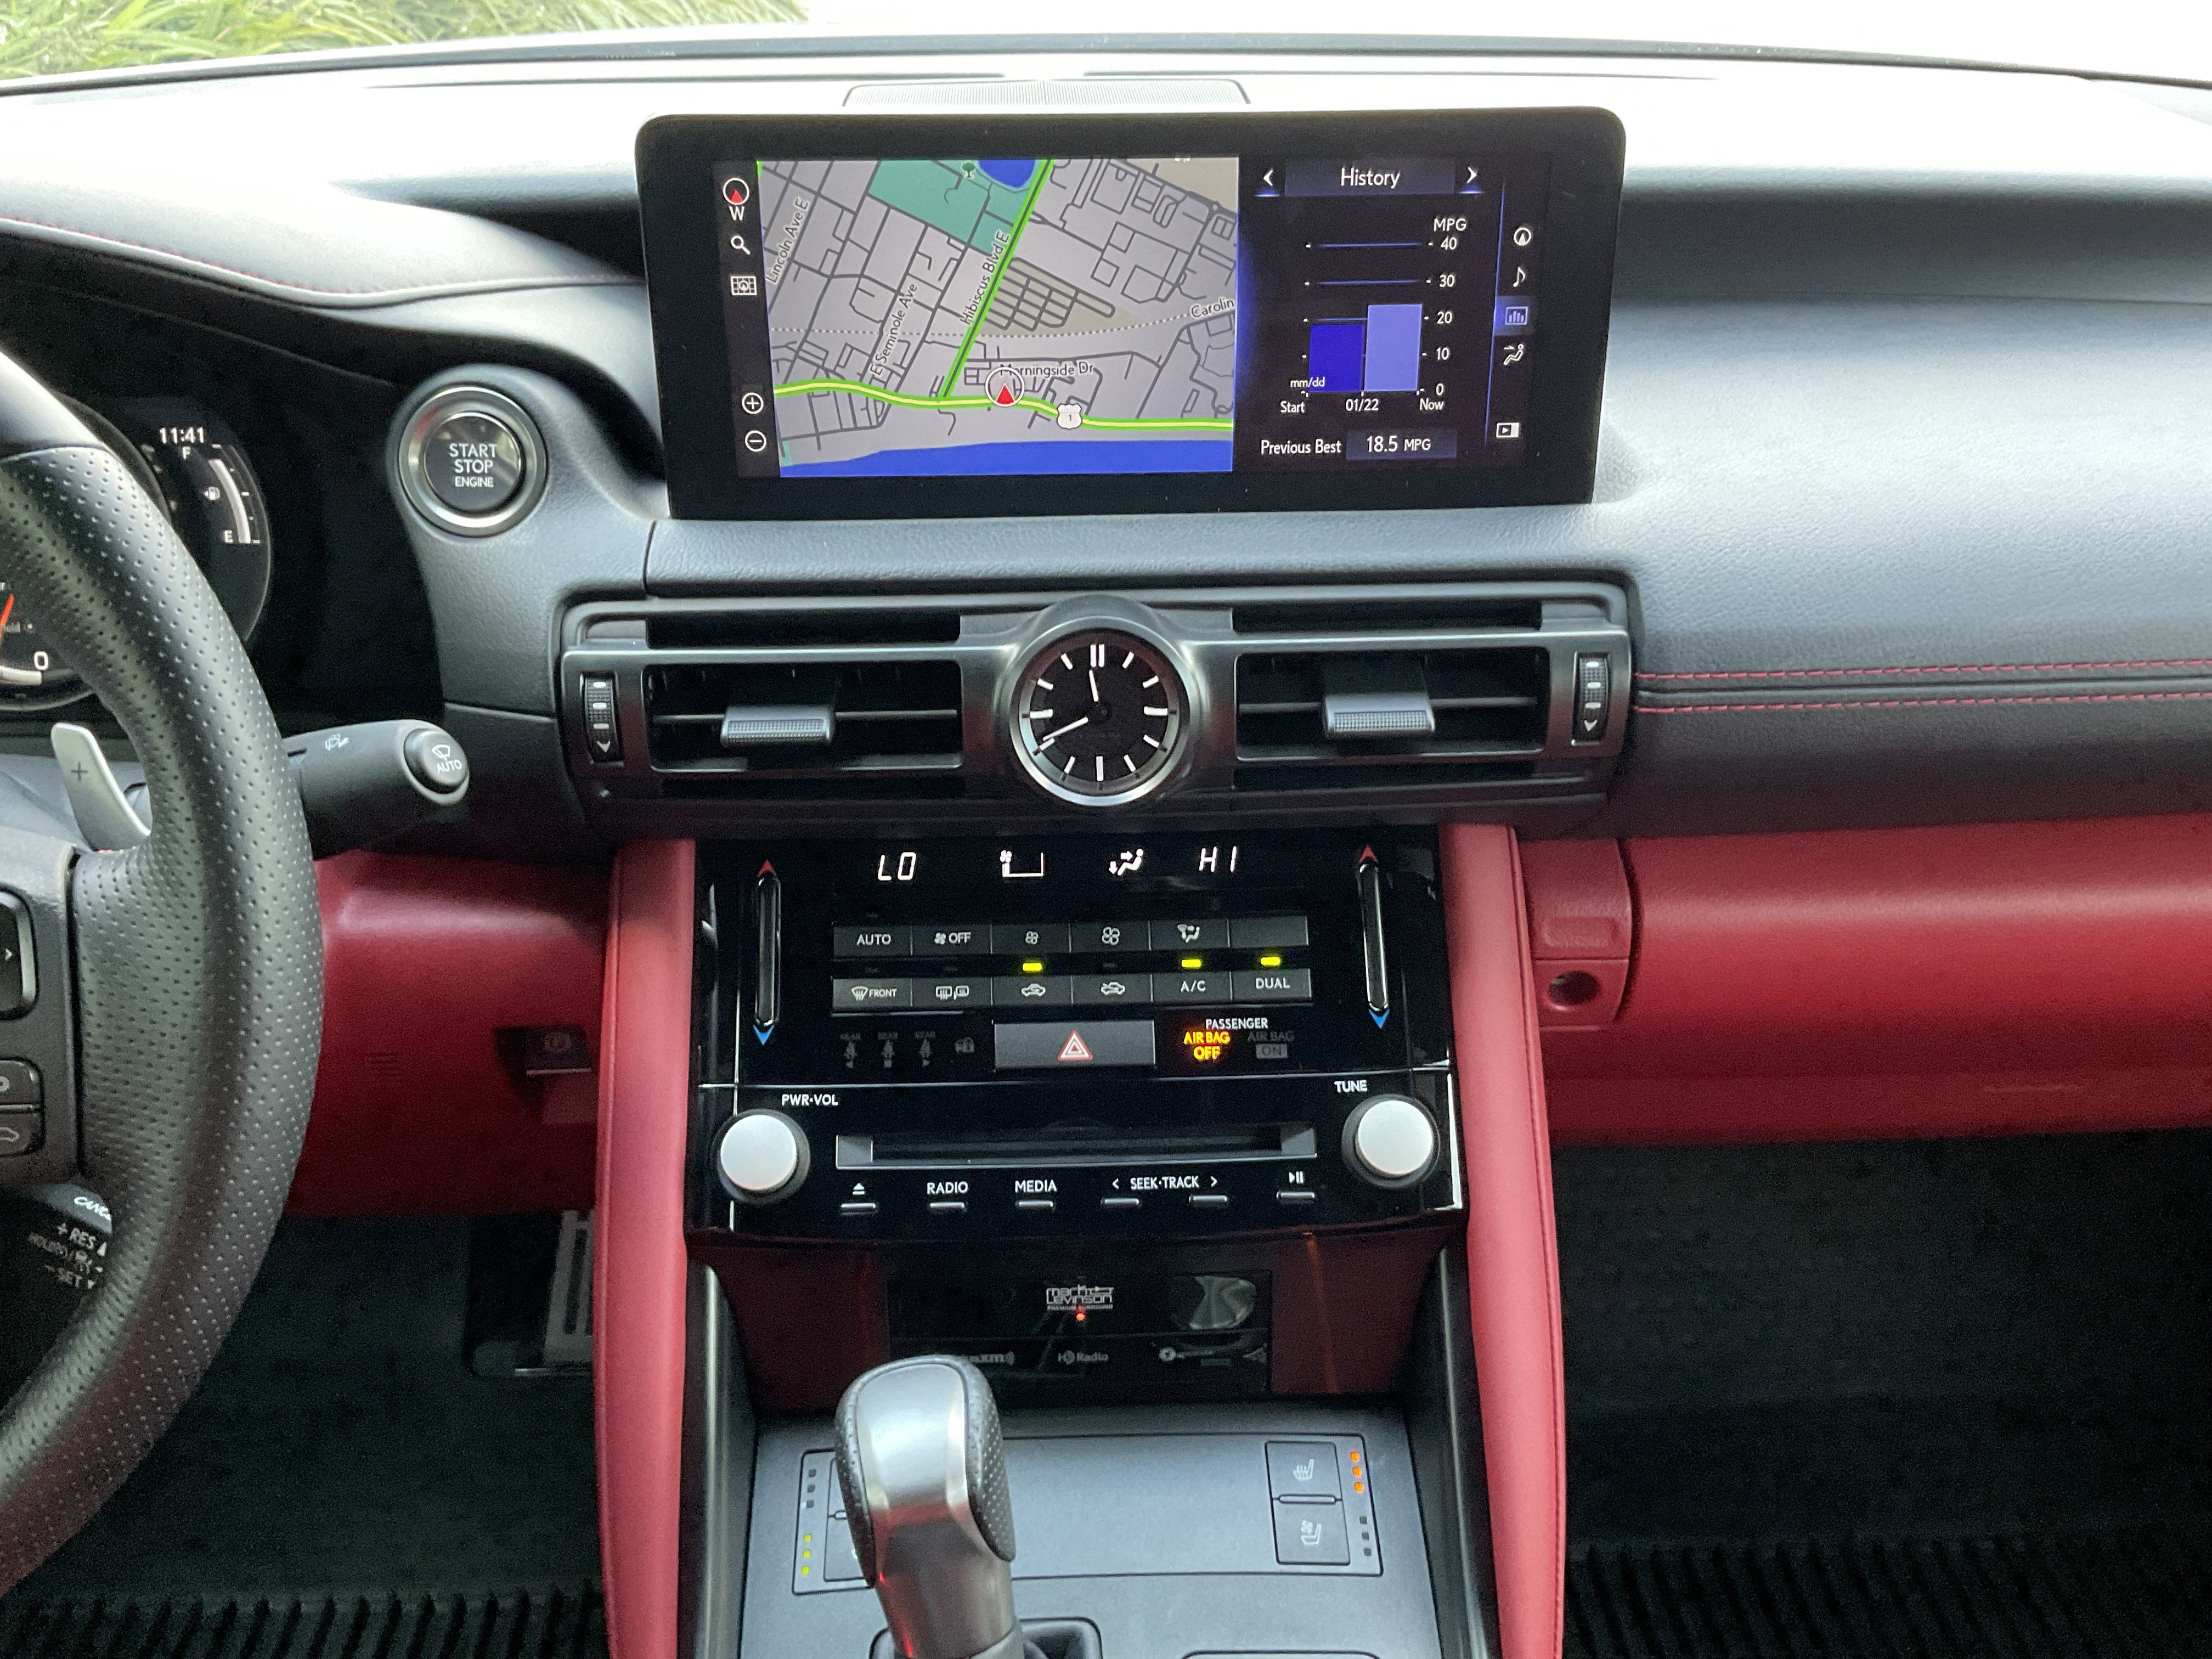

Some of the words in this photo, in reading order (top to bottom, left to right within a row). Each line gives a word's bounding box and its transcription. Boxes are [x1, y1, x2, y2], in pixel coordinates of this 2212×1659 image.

[1341, 168, 1400, 189] History
[729, 206, 745, 221] W
[1433, 218, 1467, 232] MPG
[766, 239, 792, 284] Lincoln
[785, 211, 803, 238] Ave
[795, 198, 809, 210] E
[1441, 237, 1458, 250] 40
[960, 276, 990, 325] Hibiscus
[982, 242, 1003, 273] Blvd
[996, 230, 1009, 243] E
[1439, 274, 1455, 287] 30
[899, 284, 917, 309] Ave
[1191, 298, 1234, 318] Carolin
[1437, 311, 1453, 325] 20
[876, 308, 905, 364] Seminole
[1436, 347, 1450, 360] 10
[870, 363, 883, 376] E
[1079, 362, 1093, 374] Dr
[1290, 376, 1325, 388] mm/dd
[1436, 383, 1444, 396] 0
[1280, 400, 1305, 413] Start
[1345, 398, 1379, 412] 01/22
[1419, 398, 1444, 410] Now
[159, 427, 205, 444] 11:41
[449, 442, 498, 458] START
[1261, 439, 1311, 455] Previous
[1315, 438, 1342, 454] Best
[1367, 435, 1398, 453] 18.5
[1403, 438, 1431, 452] MPG
[182, 445, 191, 460] F
[454, 459, 494, 473] STOP
[454, 476, 494, 488] ENGINE
[224, 529, 234, 543] E
[33, 651, 49, 670] 0
[436, 758, 462, 774] AUTO
[877, 851, 917, 881] LO
[1199, 846, 1238, 873] HI
[856, 933, 891, 946] AUTO
[947, 931, 972, 944] OFF
[1180, 980, 1206, 994] A/C
[1255, 977, 1290, 990] DUAL
[868, 988, 898, 998] FRONT
[1205, 1017, 1269, 1030] PASSENGER
[1183, 1031, 1205, 1045] AIR
[1205, 1030, 1231, 1045] BAG
[1247, 1031, 1268, 1043] AIR
[1269, 1030, 1295, 1042] BAG
[1193, 1045, 1221, 1060] OFF
[1261, 1045, 1283, 1057] ON
[1334, 1080, 1368, 1093] TUNE
[926, 1181, 969, 1194] RADIO
[1014, 1179, 1057, 1193] MEDIA
